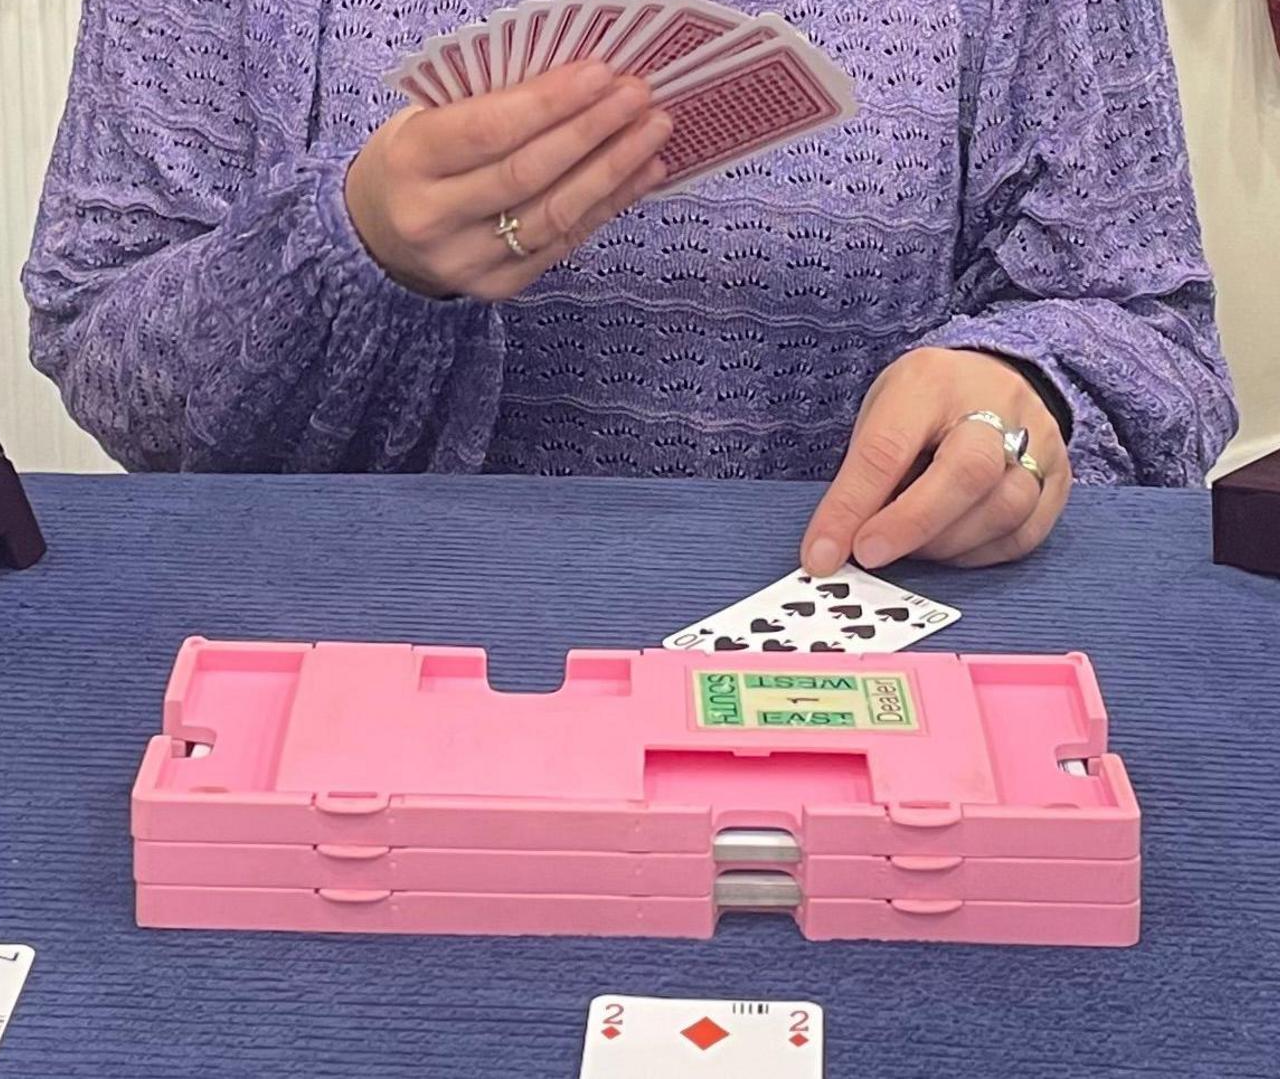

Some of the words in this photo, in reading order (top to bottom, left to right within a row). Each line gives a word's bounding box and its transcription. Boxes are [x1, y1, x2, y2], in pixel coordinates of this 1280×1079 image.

[918, 608, 950, 625] 10
[751, 675, 853, 689] WEST
[707, 673, 738, 725] SOUTH
[873, 678, 904, 723] Dealer
[763, 711, 853, 725] EAST
[602, 1003, 624, 1025] 2
[789, 1010, 810, 1032] 2
